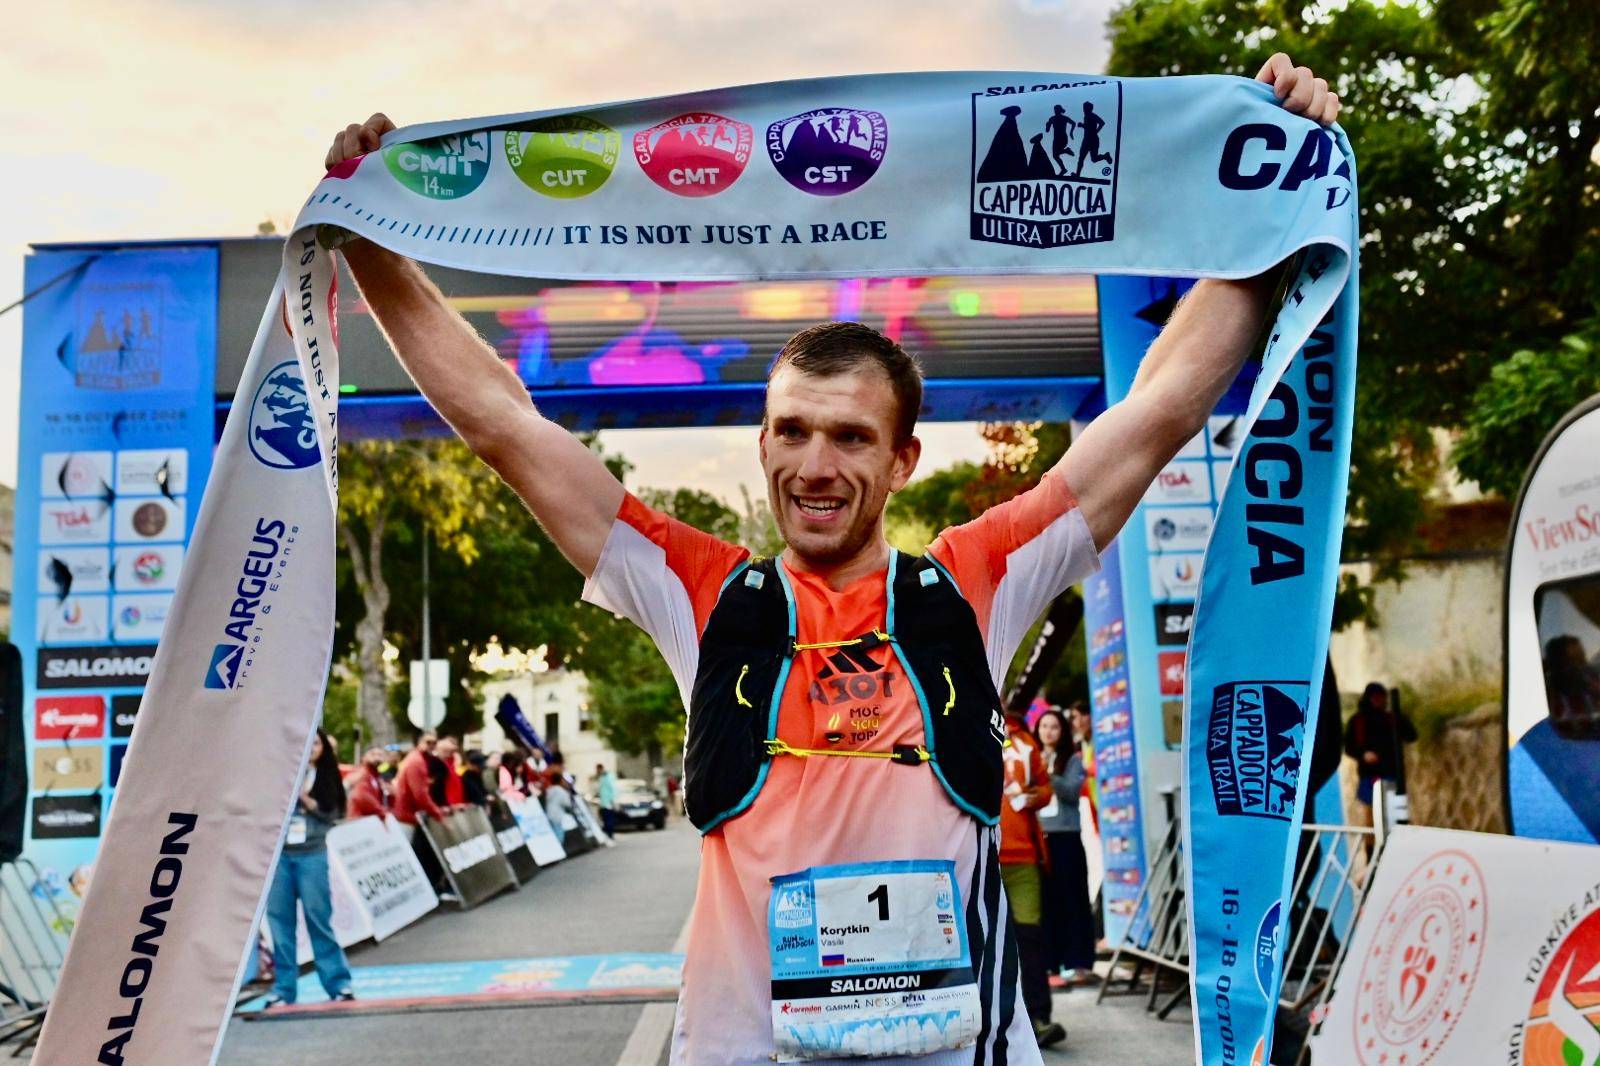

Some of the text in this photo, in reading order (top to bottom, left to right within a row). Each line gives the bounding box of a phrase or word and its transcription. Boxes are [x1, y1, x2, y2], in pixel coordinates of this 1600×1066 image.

[985, 80, 1107, 97] SALOMON
[397, 150, 474, 177] CMIT
[1218, 123, 1351, 191] CA
[541, 168, 588, 188] CUT
[668, 167, 721, 186] CMT
[804, 164, 853, 185] CST
[979, 182, 1107, 216] CAPPADOCIA
[563, 220, 887, 245] IT IS NOT JUST A RACE
[982, 217, 1103, 245] ULTRA TRAIL
[300, 237, 316, 267] IS
[299, 271, 315, 327] NOT
[306, 336, 331, 401] JUST
[1303, 304, 1336, 453] MON
[1243, 380, 1306, 586] OCIA
[224, 517, 286, 643] ARGEUS
[236, 525, 300, 690] Travel & Events
[45, 655, 157, 679] SALOMO
[1210, 694, 1237, 806] ULTRA TRAIL
[1236, 688, 1266, 808] CAPPADOCIA
[867, 884, 890, 921] 1
[1222, 887, 1240, 915] 16
[97, 812, 199, 1066] ALOMON
[820, 924, 870, 937] Korytkin
[1221, 938, 1238, 967] 18
[830, 974, 921, 994] SALOMON
[790, 1003, 823, 1015] corendon
[825, 1003, 861, 1012] GARMIN
[1215, 974, 1236, 1066] OCTOB
[1508, 1021, 1524, 1066] TUR
